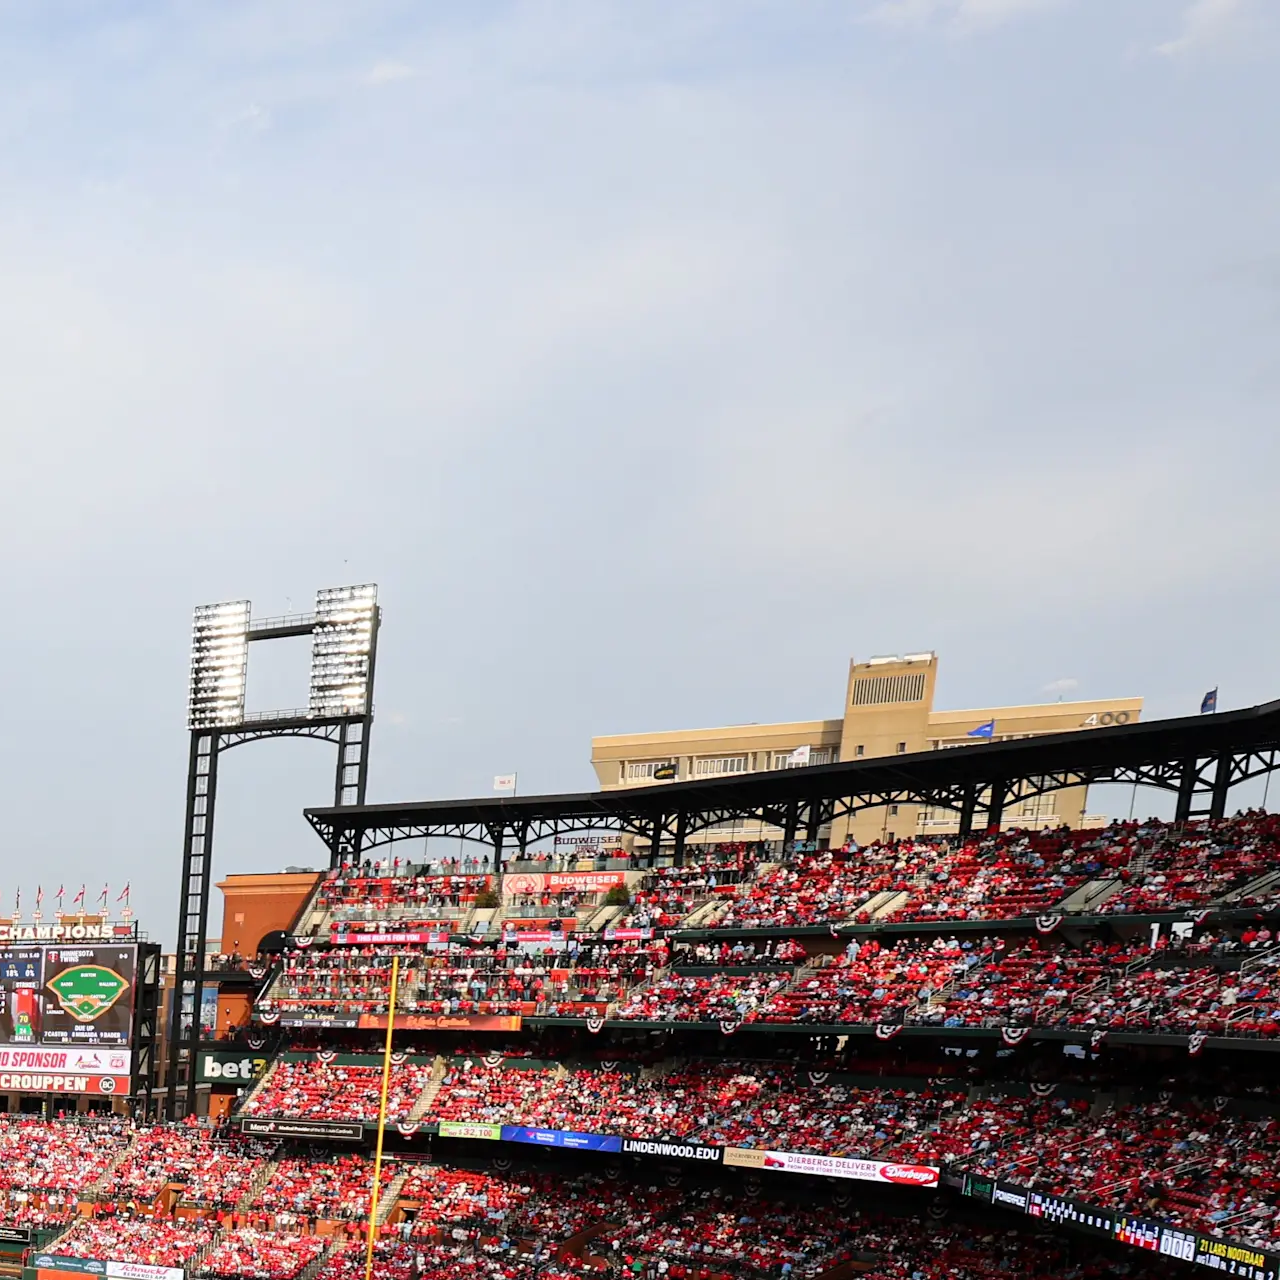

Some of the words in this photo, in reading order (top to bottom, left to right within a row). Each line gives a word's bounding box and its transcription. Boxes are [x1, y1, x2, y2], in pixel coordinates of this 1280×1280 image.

[554, 836, 622, 845] BUDWEISER
[550, 875, 618, 885] BUDWEISER
[407, 934, 420, 942] YOU
[11, 1052, 67, 1068] SPONSOR
[0, 1074, 86, 1091] CROUPPEN
[250, 1123, 270, 1132] Mercy
[623, 1140, 719, 1160] LINDENWOOD.EDU
[788, 1156, 833, 1167] DIERBERGS
[836, 1160, 877, 1171] DELIVERS
[885, 1167, 935, 1182] Dierbergs
[995, 1190, 1026, 1207] POWERADE
[1200, 1240, 1208, 1251] 21
[1209, 1242, 1226, 1256] LARS
[1227, 1246, 1265, 1267] NOOTBAAR
[119, 1264, 171, 1275] Schnucks
